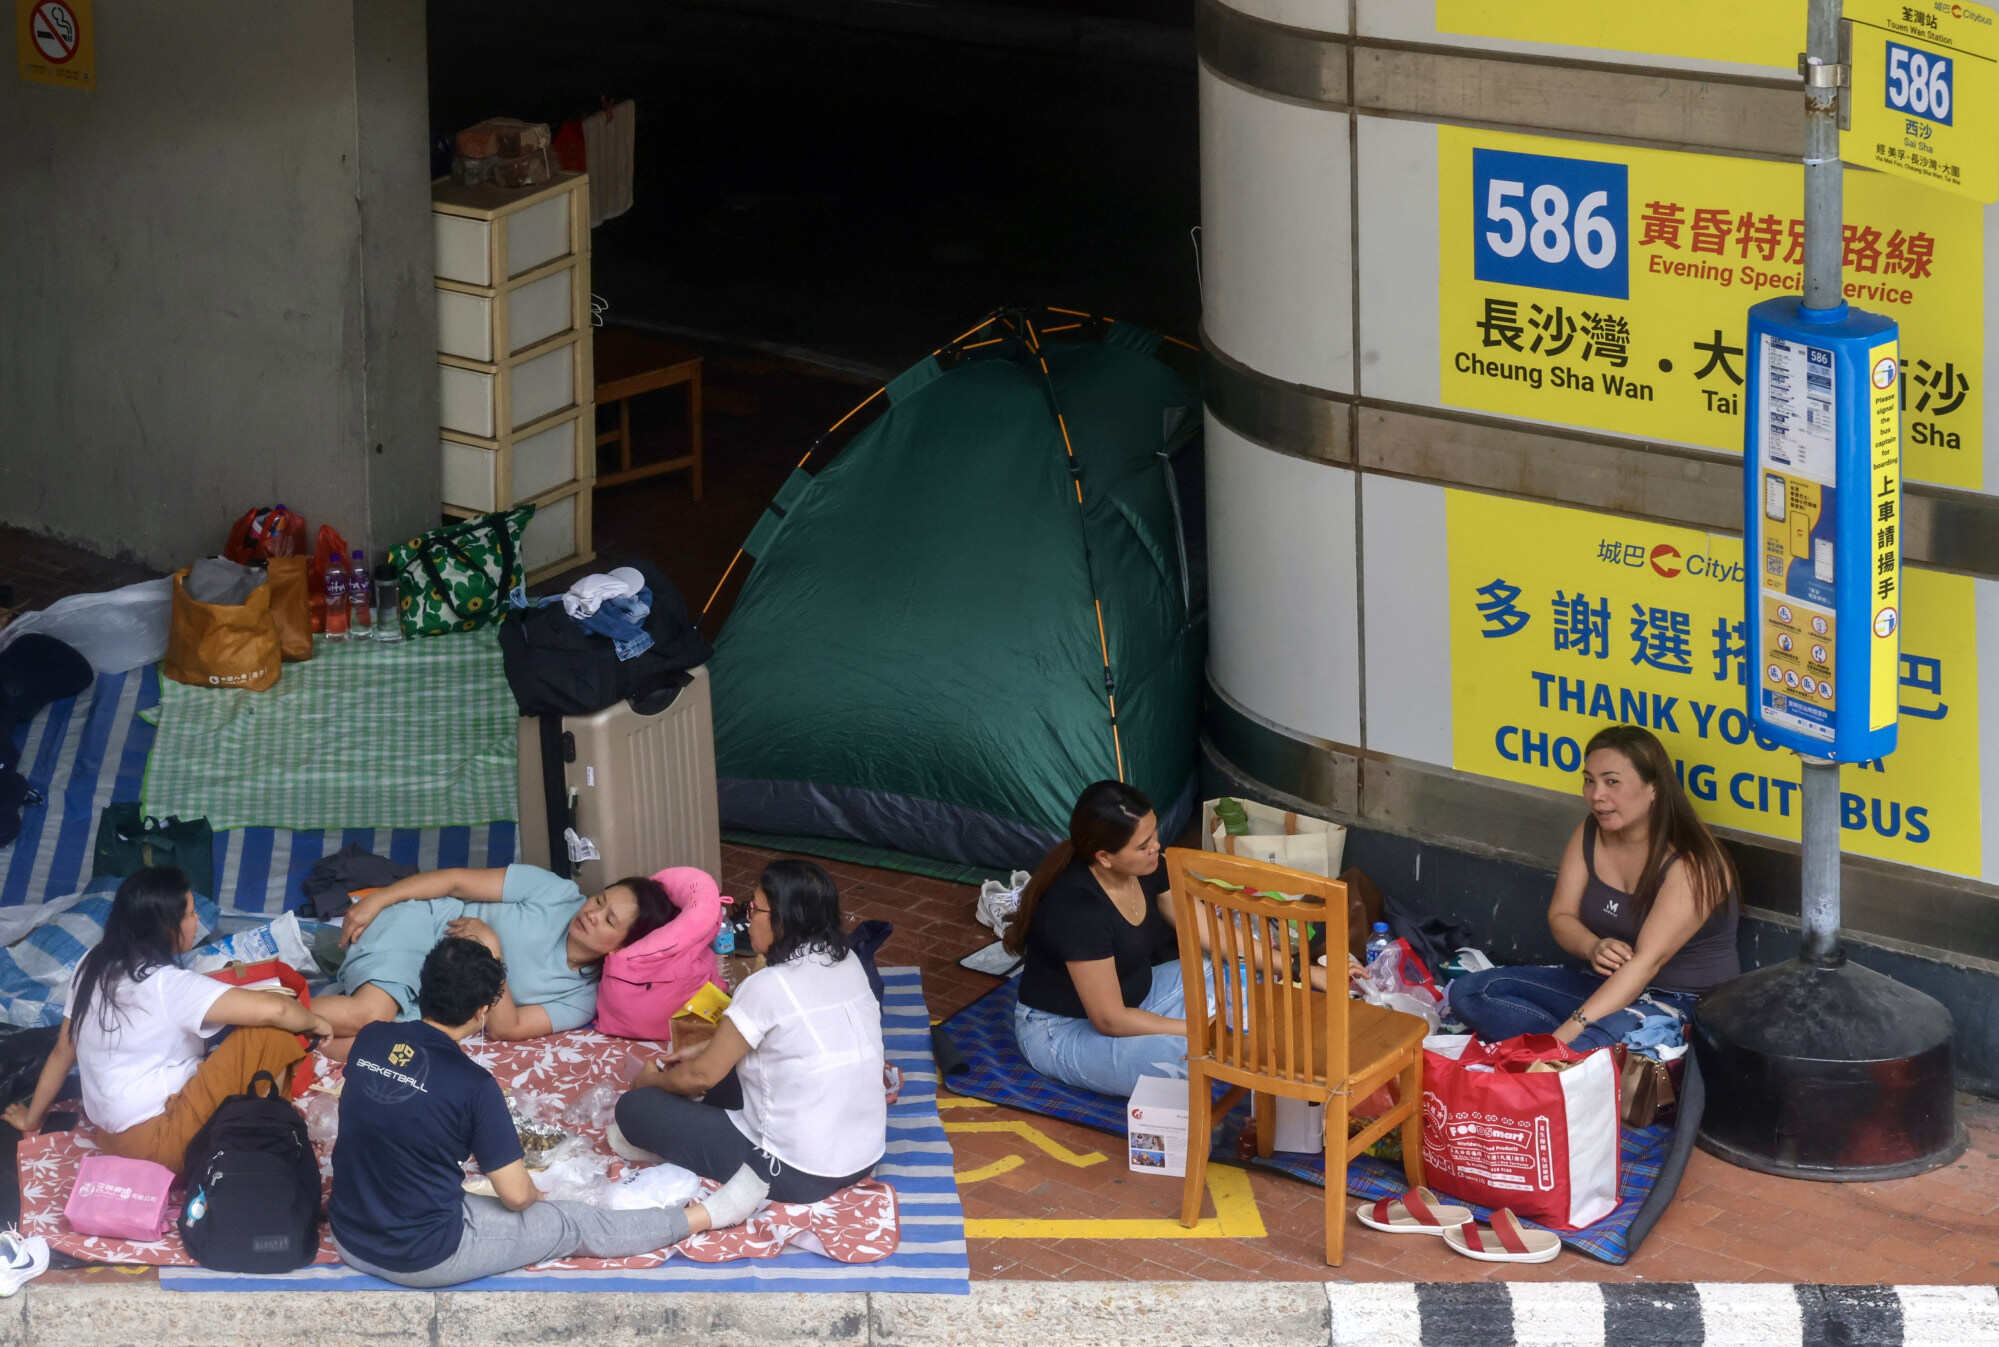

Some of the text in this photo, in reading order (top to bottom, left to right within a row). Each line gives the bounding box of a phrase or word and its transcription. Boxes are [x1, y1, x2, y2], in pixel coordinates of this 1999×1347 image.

[1887, 19, 1953, 46] Tsuen Wan Station
[1902, 6, 1938, 30] 荃灣站
[1888, 47, 1950, 119] 586
[1905, 118, 1932, 140] 西沙
[1918, 141, 1934, 154] Sha
[1486, 178, 1617, 269] 586
[1649, 254, 1913, 305] Evening Speci ervice
[1476, 298, 1745, 386] 長沙灣 大
[1810, 350, 1828, 364] 586
[1455, 352, 1654, 401] Cheung Sha Wan
[1900, 359, 1970, 416] 沙
[1701, 389, 1738, 415] Tai
[1875, 394, 1895, 405] Please
[1911, 421, 1961, 450] Sha
[1873, 457, 1898, 471] boarding
[1877, 475, 1895, 600] 上車請揚手
[1597, 538, 1745, 583] 城巴 Cityb
[1531, 670, 1680, 734] THANK
[1729, 772, 1931, 843] CITBUS
[356, 1058, 428, 1094] BASKETBALL
